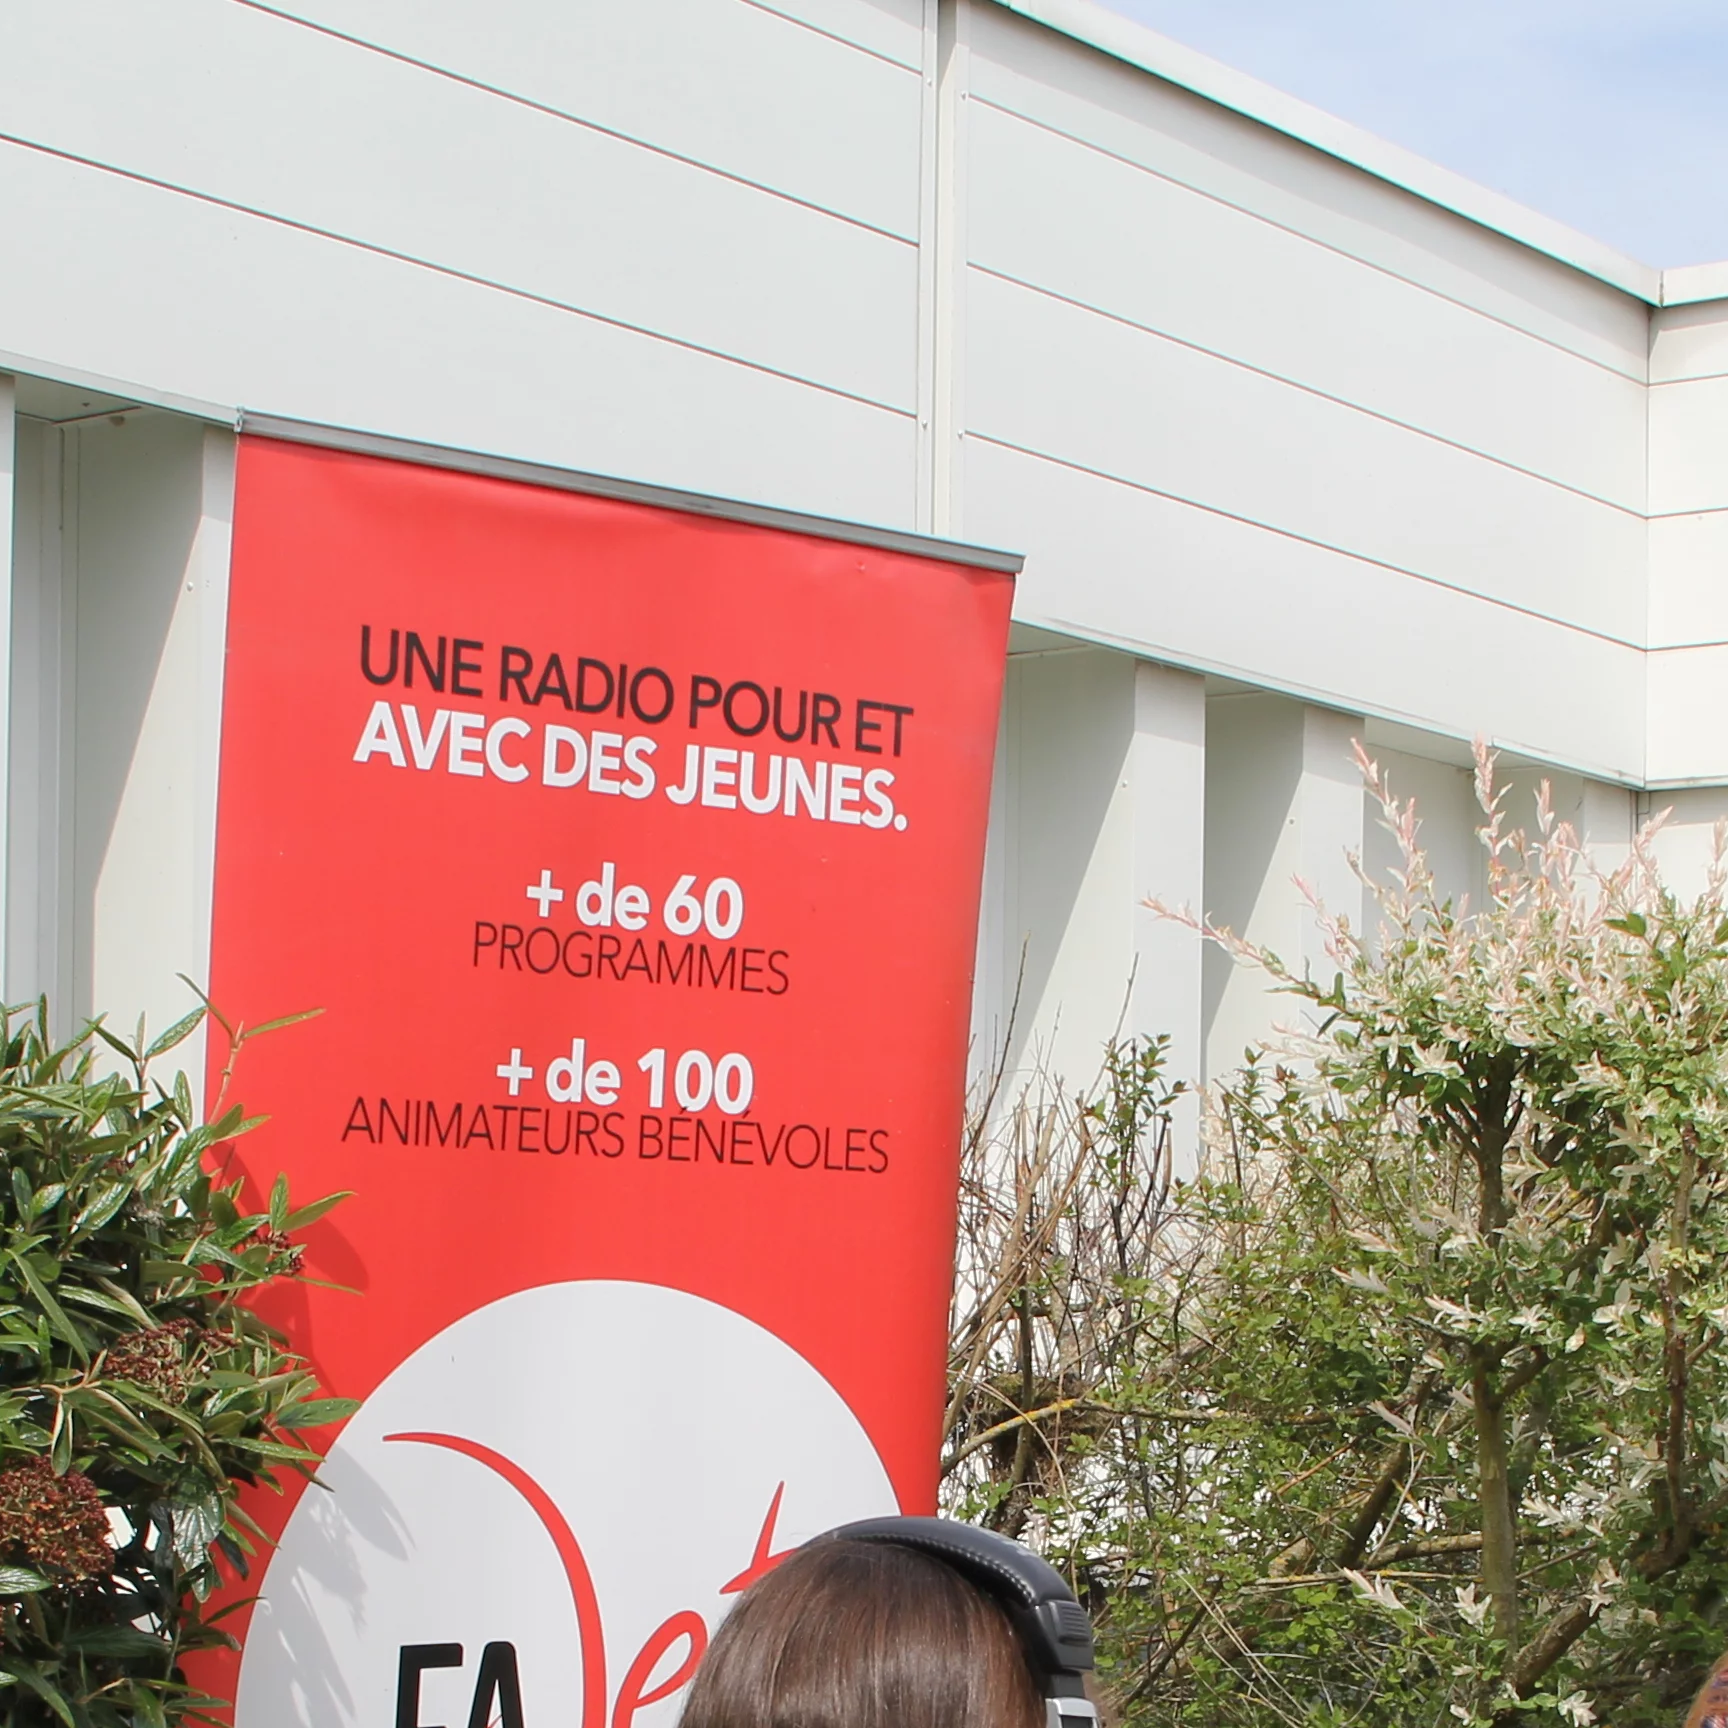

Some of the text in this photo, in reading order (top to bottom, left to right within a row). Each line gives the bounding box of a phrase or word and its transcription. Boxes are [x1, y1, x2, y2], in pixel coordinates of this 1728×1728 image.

[360, 625, 914, 758] UNE RADIO POUR ET
[353, 702, 909, 831] AVEC DES JEUNES.
[526, 862, 744, 940] + de 60
[473, 921, 790, 995] PROGRAMMES
[496, 1038, 754, 1114] + de 100
[341, 1096, 890, 1174] ANIMATEURS BÉNÉVOLES
